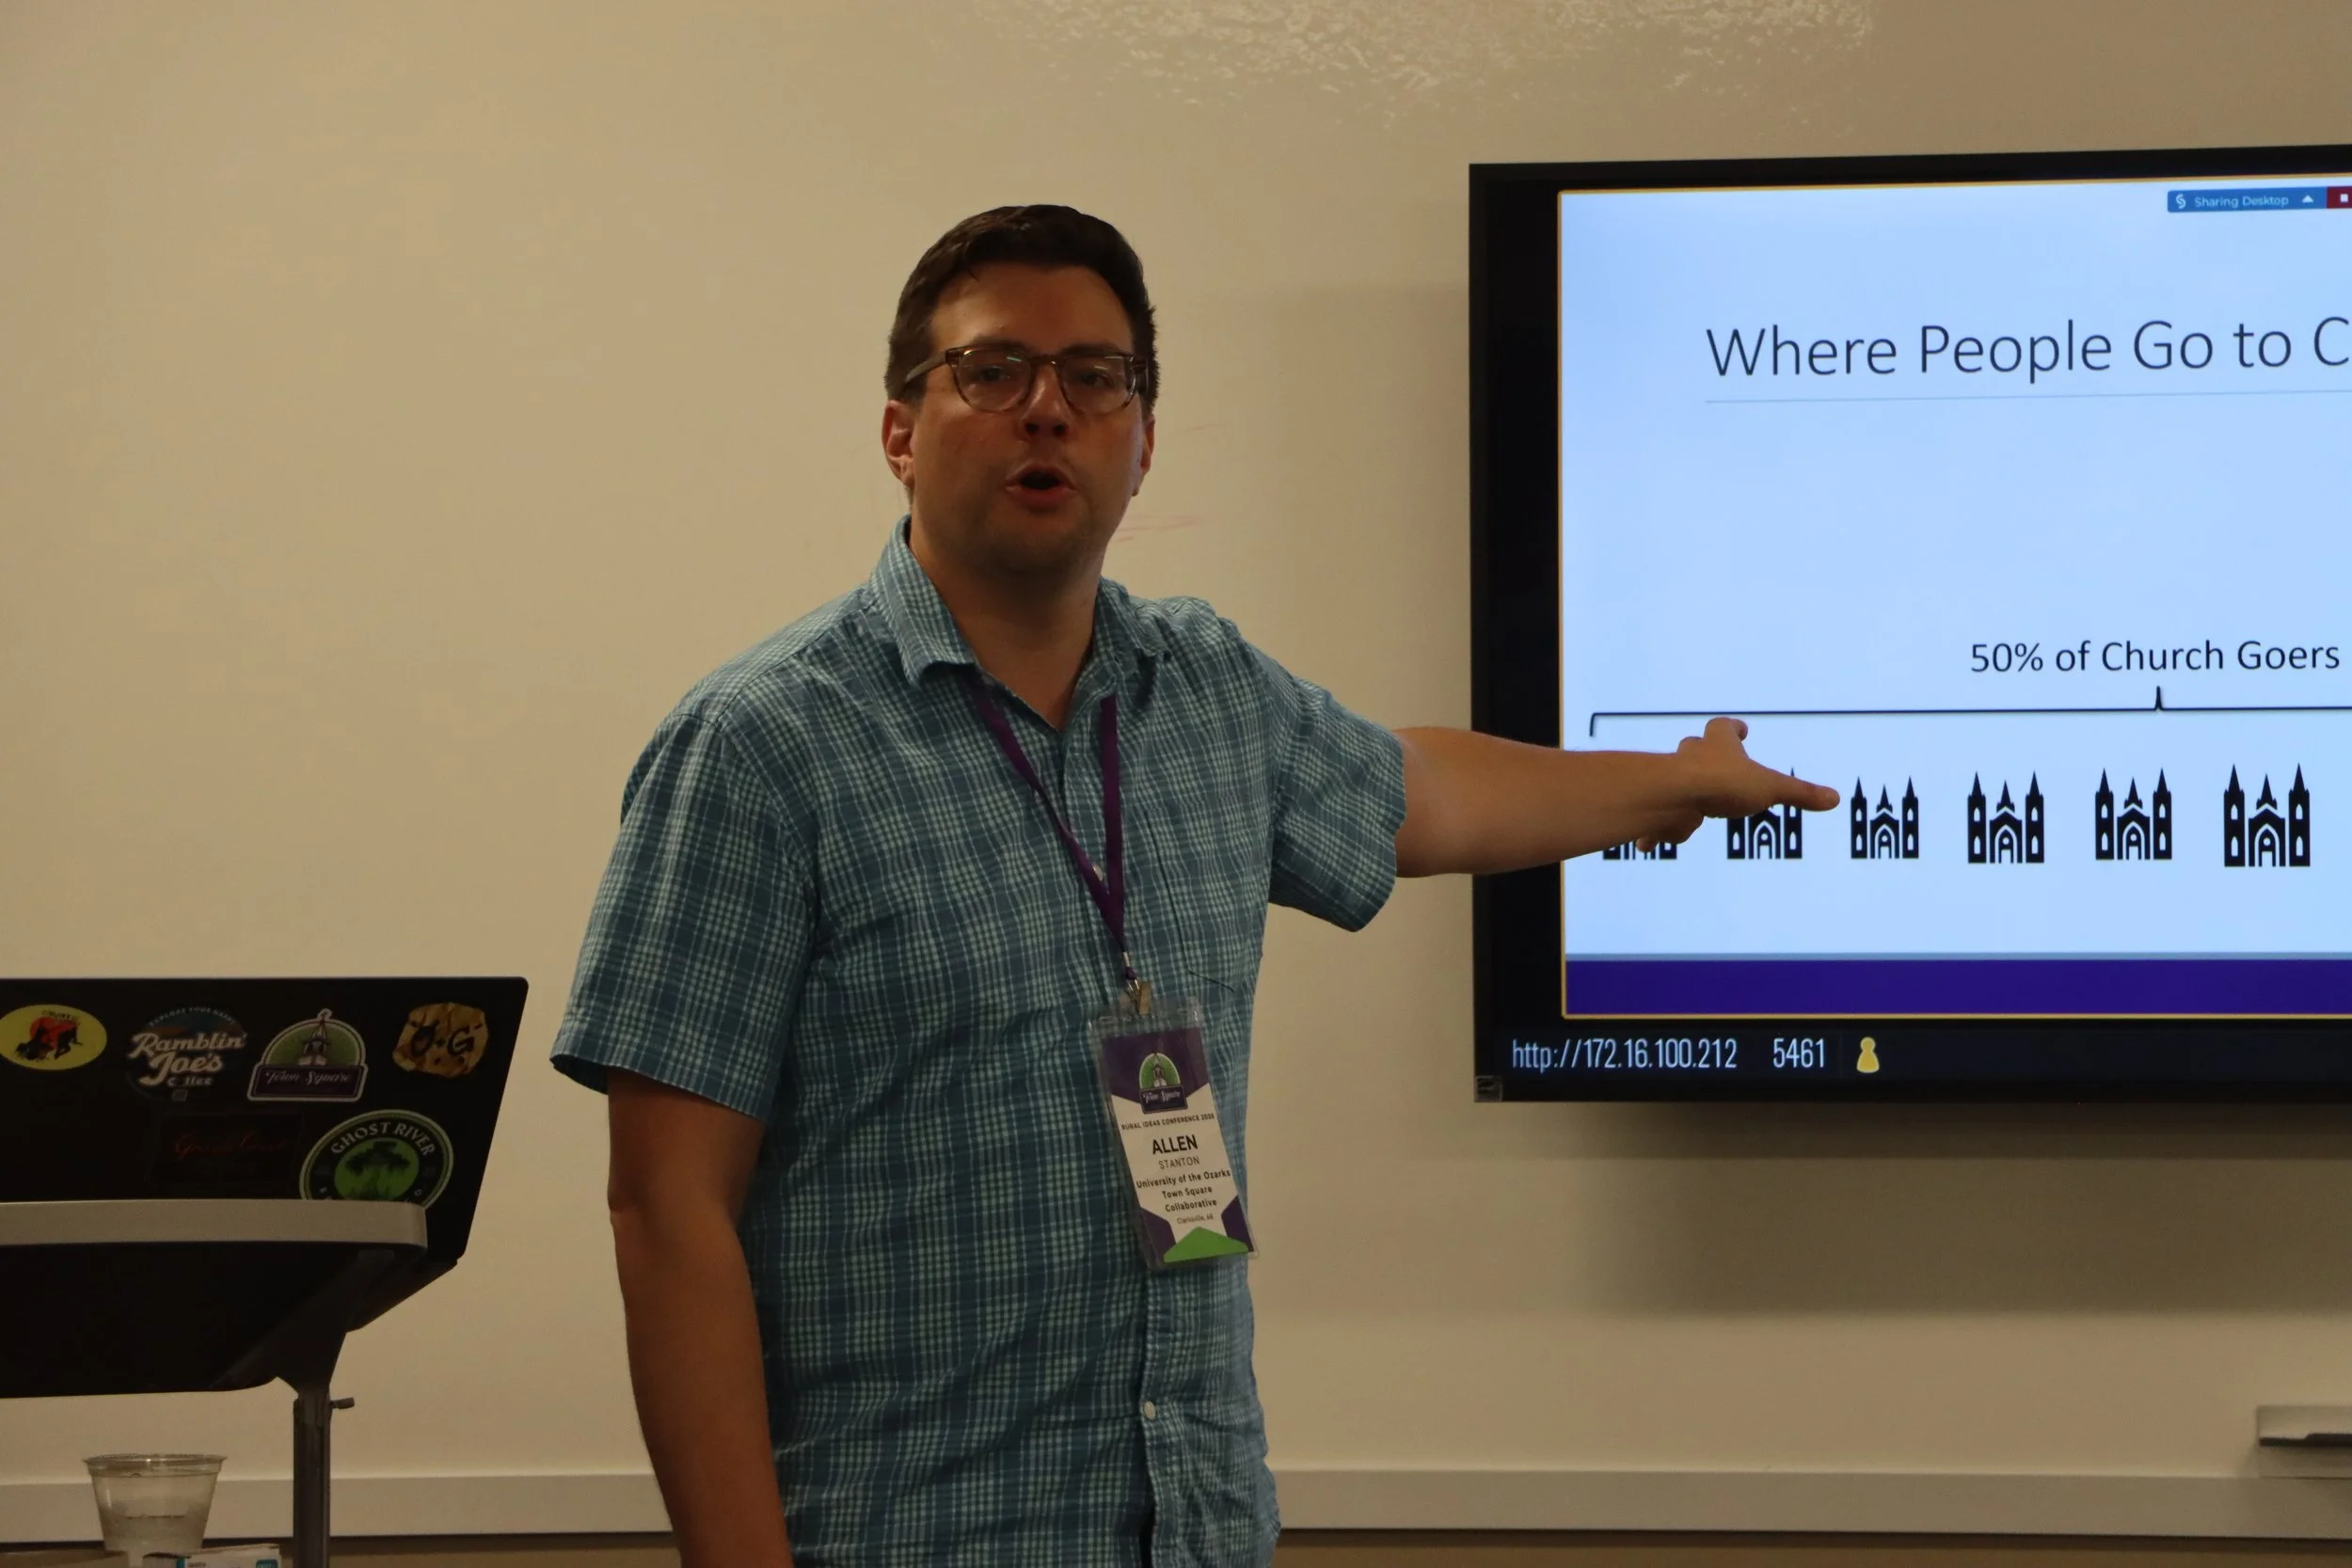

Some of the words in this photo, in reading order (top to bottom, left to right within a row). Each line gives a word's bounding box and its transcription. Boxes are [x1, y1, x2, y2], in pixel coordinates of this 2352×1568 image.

[2194, 196, 2239, 209] Sharing
[2242, 195, 2289, 207] Desktop
[1706, 325, 1897, 376] Where
[1920, 319, 2111, 384] People
[2133, 321, 2213, 371] Go
[2233, 323, 2292, 368] to
[1971, 642, 2042, 673] 50%
[2056, 641, 2090, 672] of
[2102, 641, 2223, 671] Church
[2237, 641, 2339, 671] Goers
[129, 1031, 247, 1059] Ramblin'
[1512, 1037, 1738, 1072] http://172.16.100.212
[1772, 1037, 1825, 1069] 5461
[139, 1051, 224, 1085] Joe's
[264, 1070, 300, 1085] Town
[305, 1069, 351, 1087] Square
[1121, 1121, 1141, 1131] RURAL
[1142, 1119, 1161, 1129] IDEAS
[1162, 1115, 1200, 1126] CONFERENCE
[330, 1120, 392, 1154] GHOST
[392, 1121, 437, 1157] RIVER
[1152, 1134, 1199, 1155] ALLEN
[1158, 1156, 1200, 1170] STANTON
[1136, 1176, 1176, 1189] University
[1178, 1174, 1187, 1183] of
[1188, 1172, 1202, 1181] the
[1203, 1169, 1232, 1180] Ozarks
[1162, 1190, 1184, 1199] Town
[1184, 1186, 1213, 1197] Square
[1165, 1197, 1217, 1212] Collaborative
